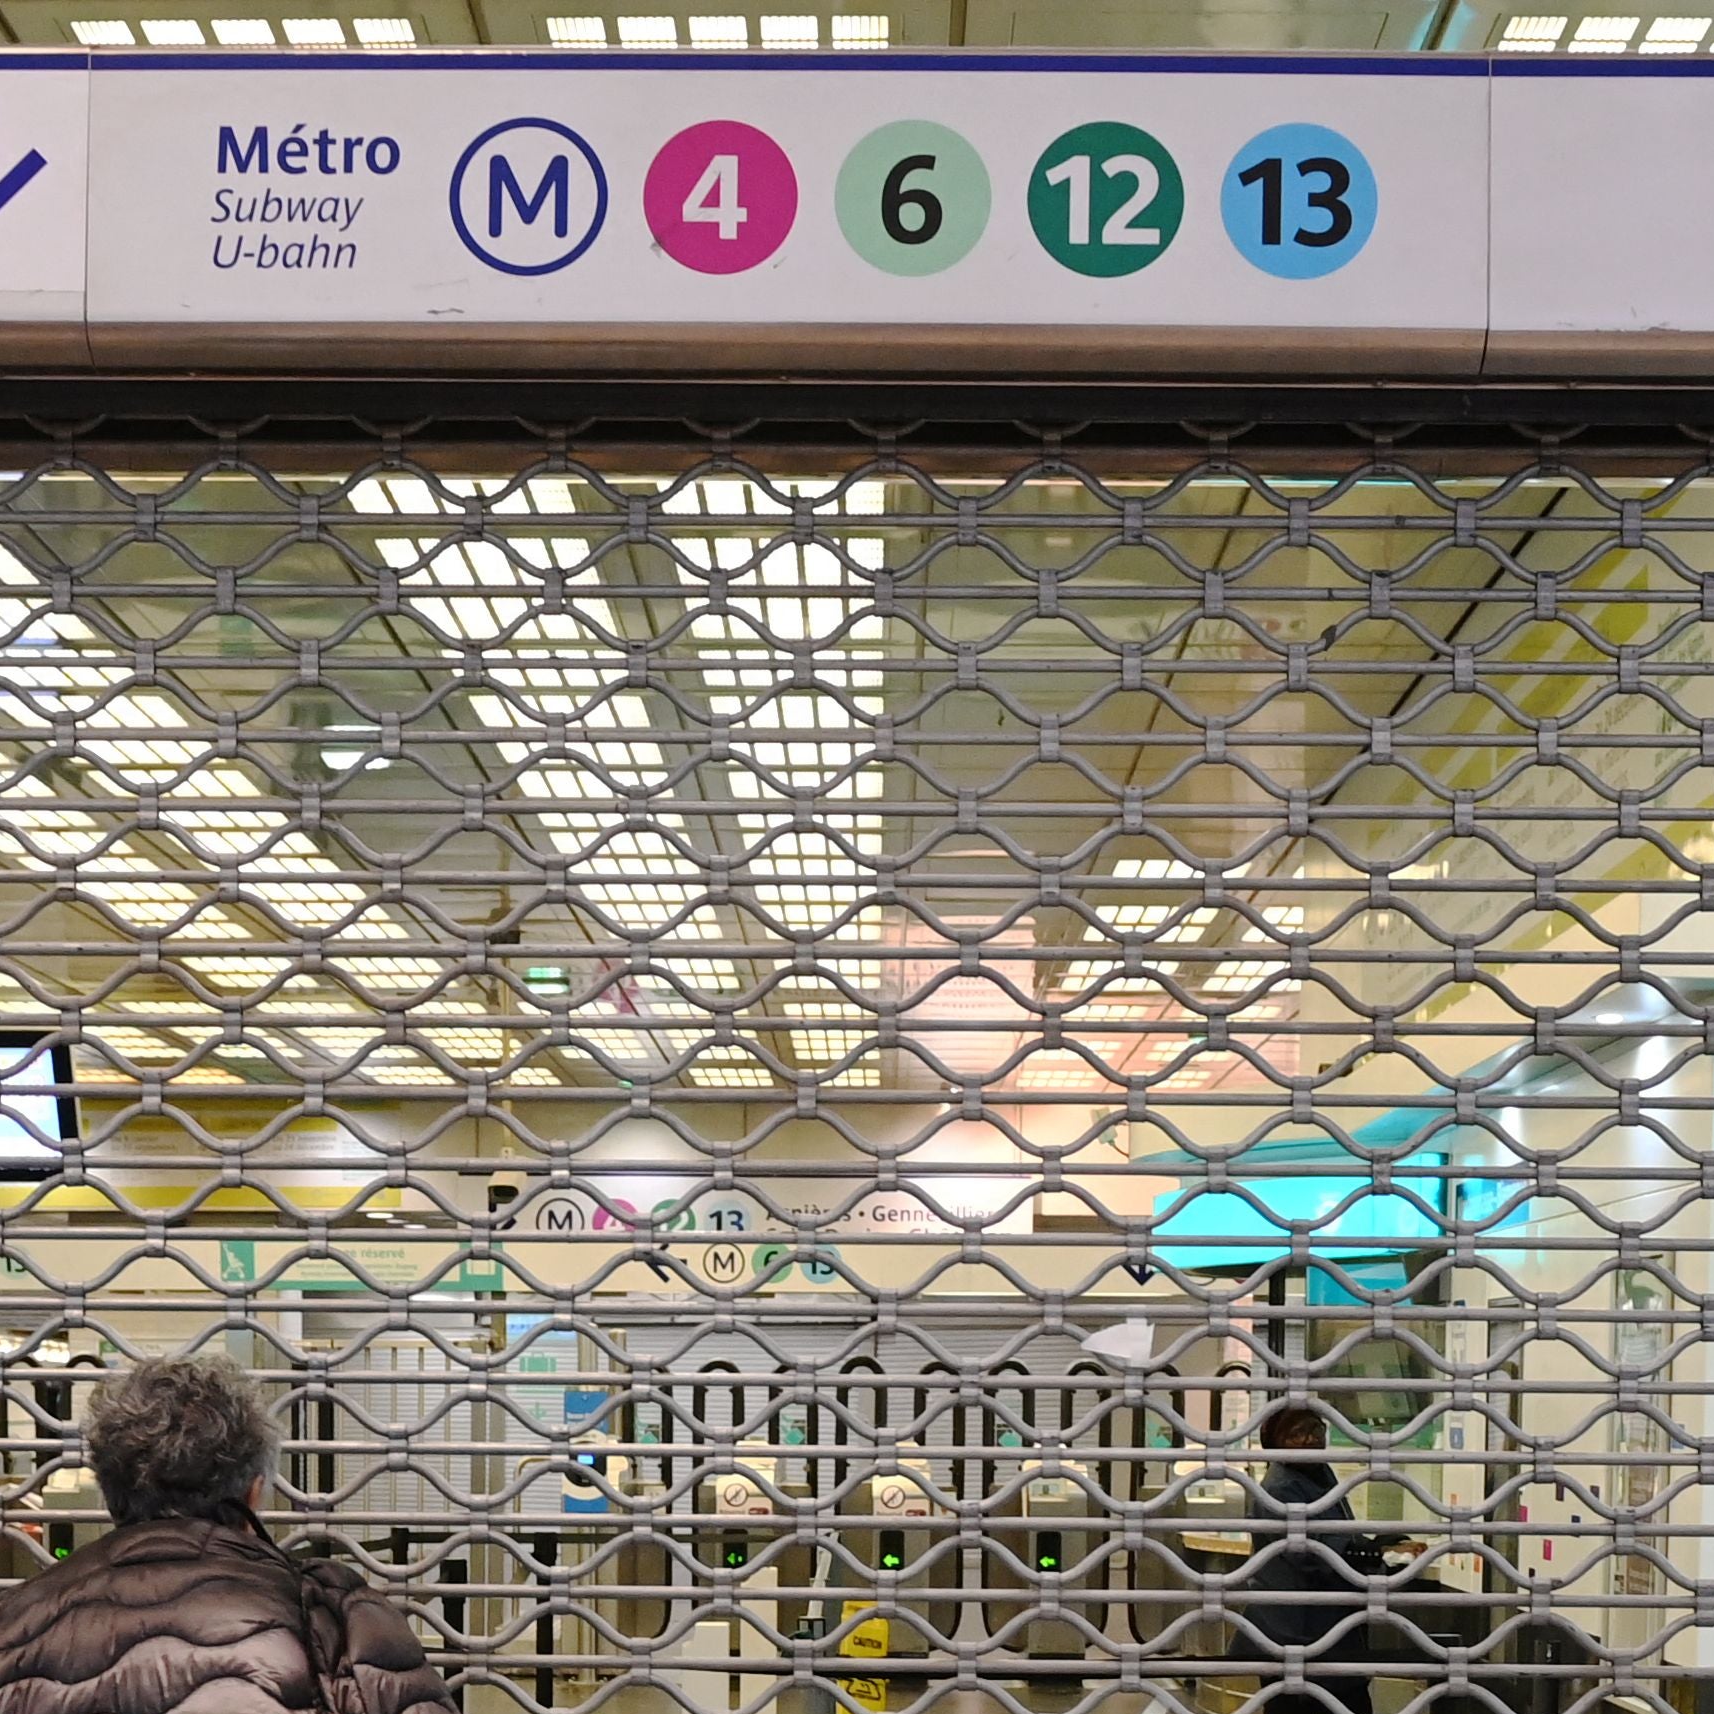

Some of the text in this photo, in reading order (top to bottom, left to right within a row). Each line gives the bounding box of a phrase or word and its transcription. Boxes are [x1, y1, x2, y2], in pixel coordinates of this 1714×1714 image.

[216, 123, 402, 176] Métro
[211, 187, 365, 232] Subway
[487, 153, 1354, 249] M 4 6 12 13
[212, 234, 358, 270] U-bahn
[709, 1209, 744, 1231] 13
[871, 1204, 998, 1223] Genneillier
[360, 1246, 406, 1260] réservé
[712, 1251, 737, 1275] M
[852, 1636, 882, 1650] CAUTION
